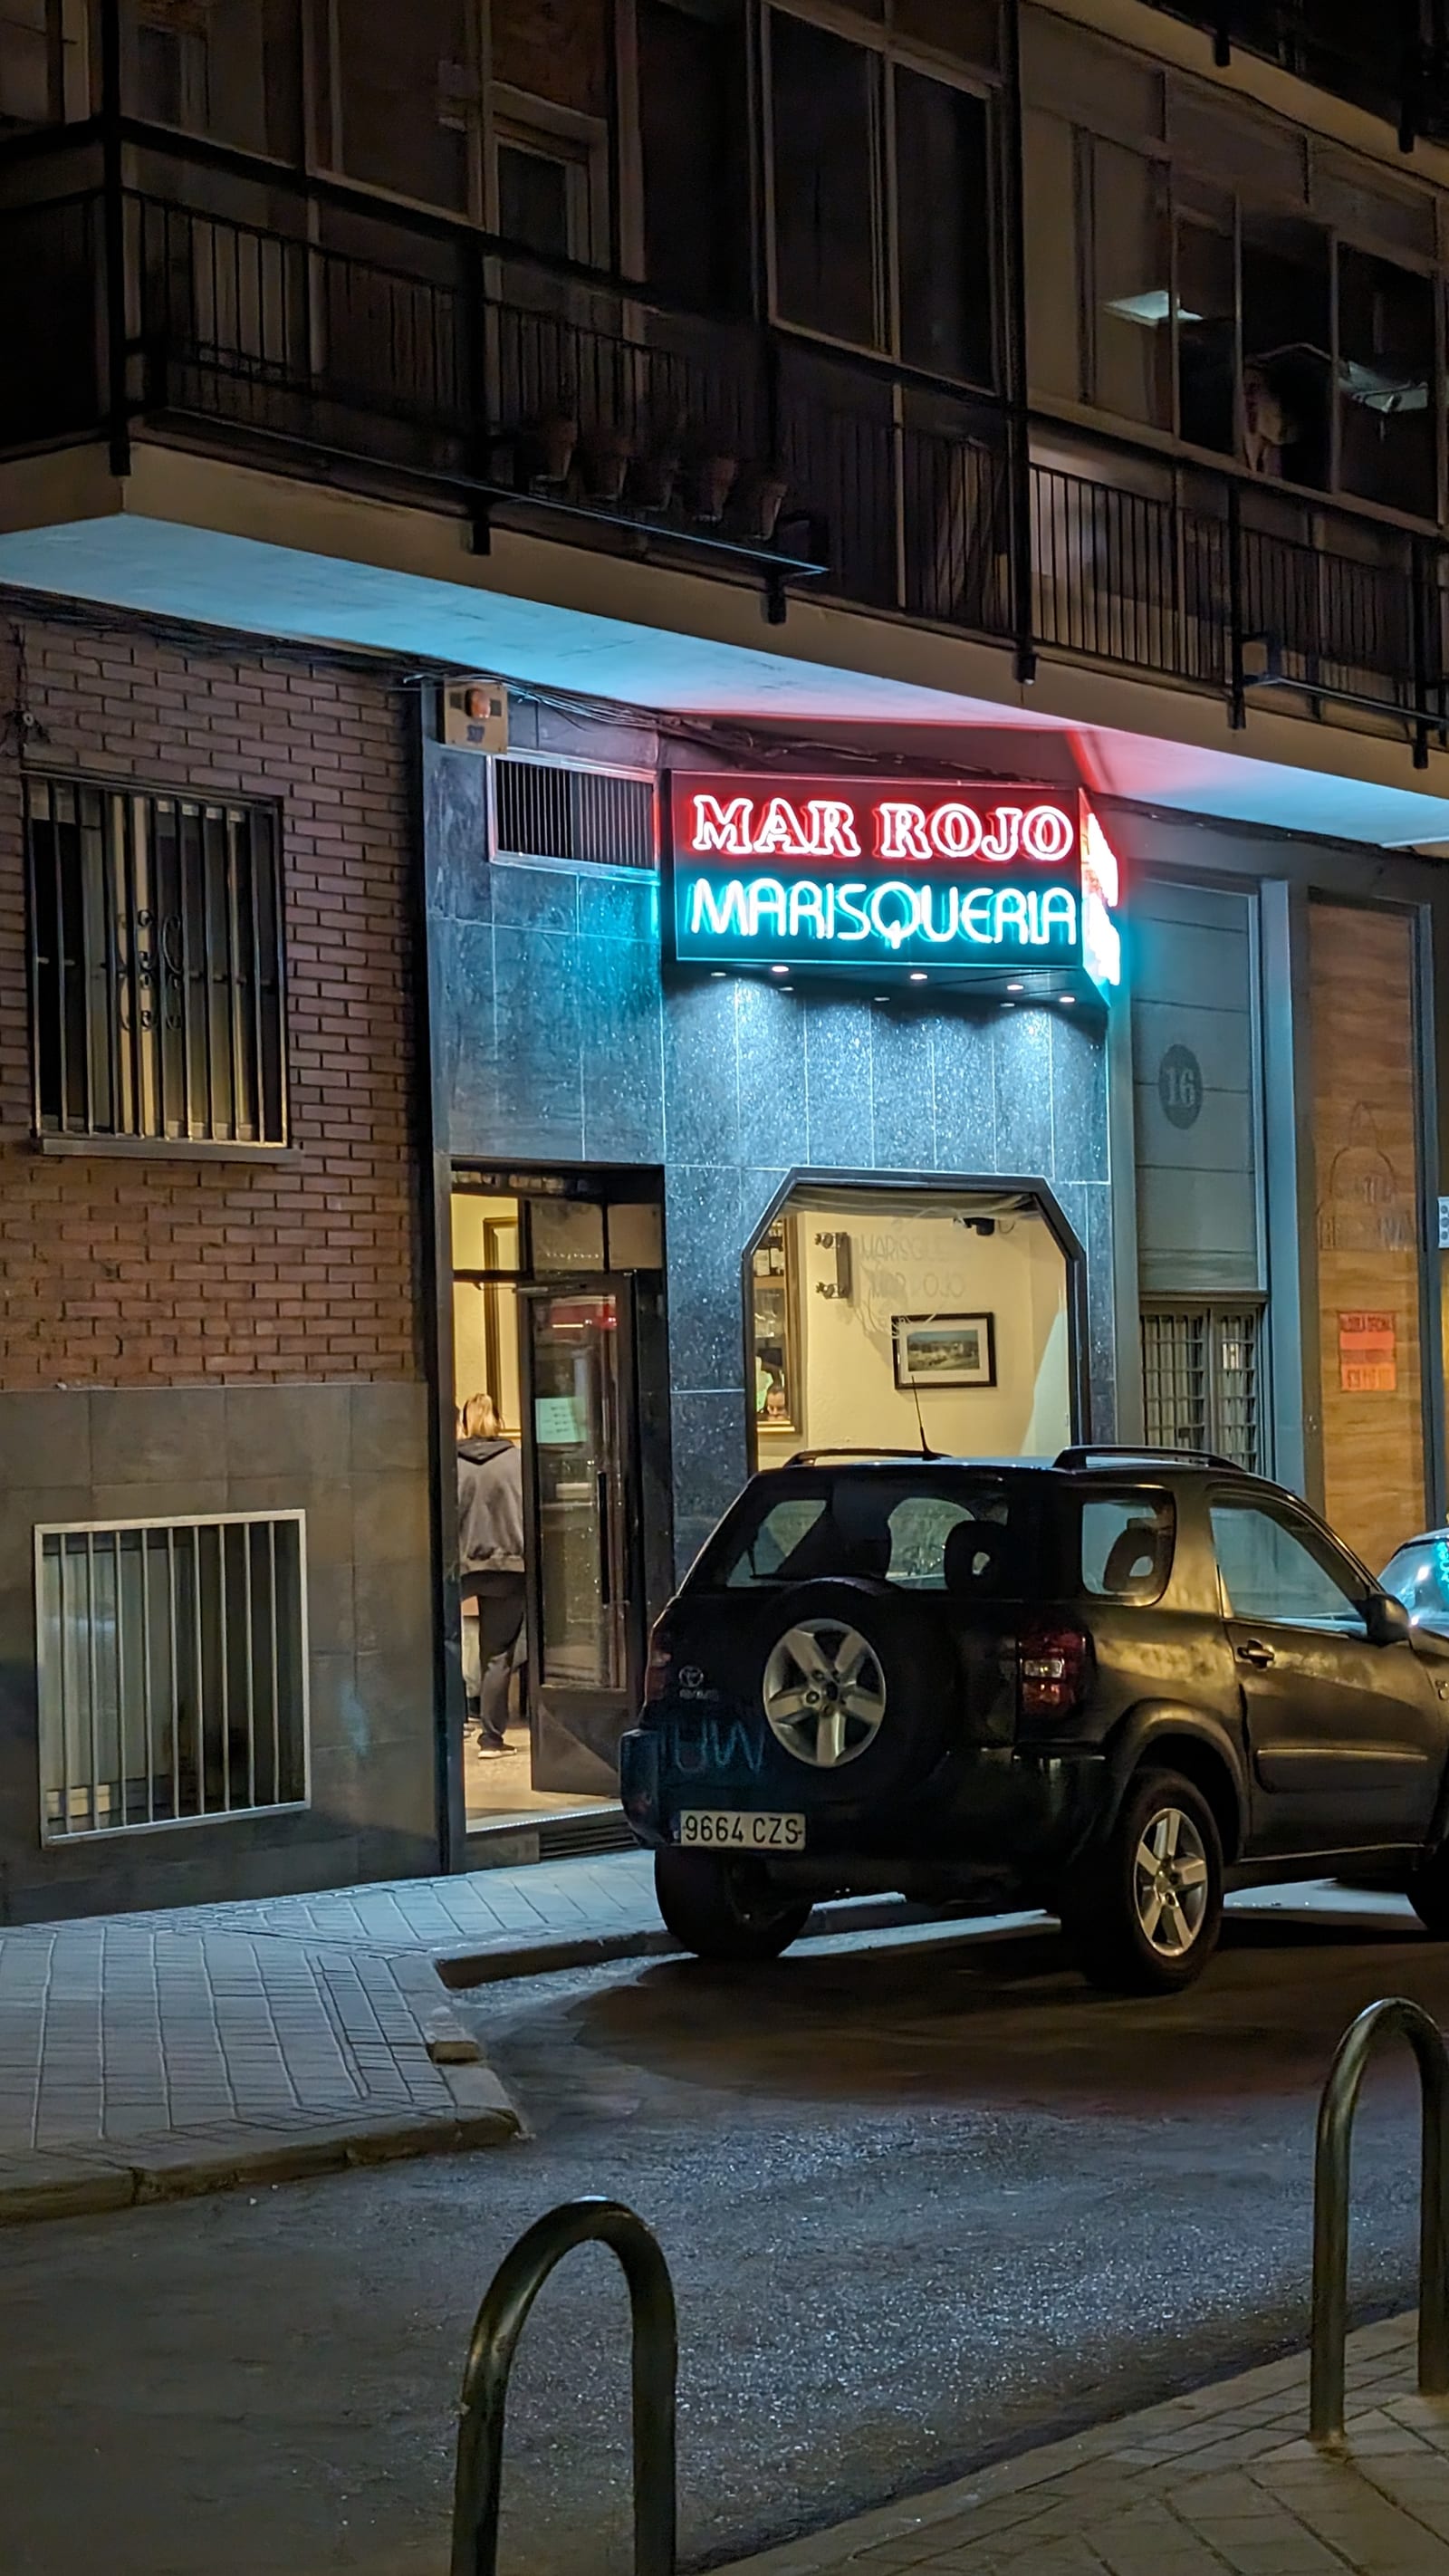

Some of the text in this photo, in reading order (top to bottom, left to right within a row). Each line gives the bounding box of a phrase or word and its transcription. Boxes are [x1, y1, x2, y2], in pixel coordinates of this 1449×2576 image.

[691, 793, 1075, 862] MAR ROJO
[689, 877, 1077, 949] MARISQUERIA
[1165, 1066, 1195, 1109] 16
[685, 1814, 800, 1845] 9664 CZS
